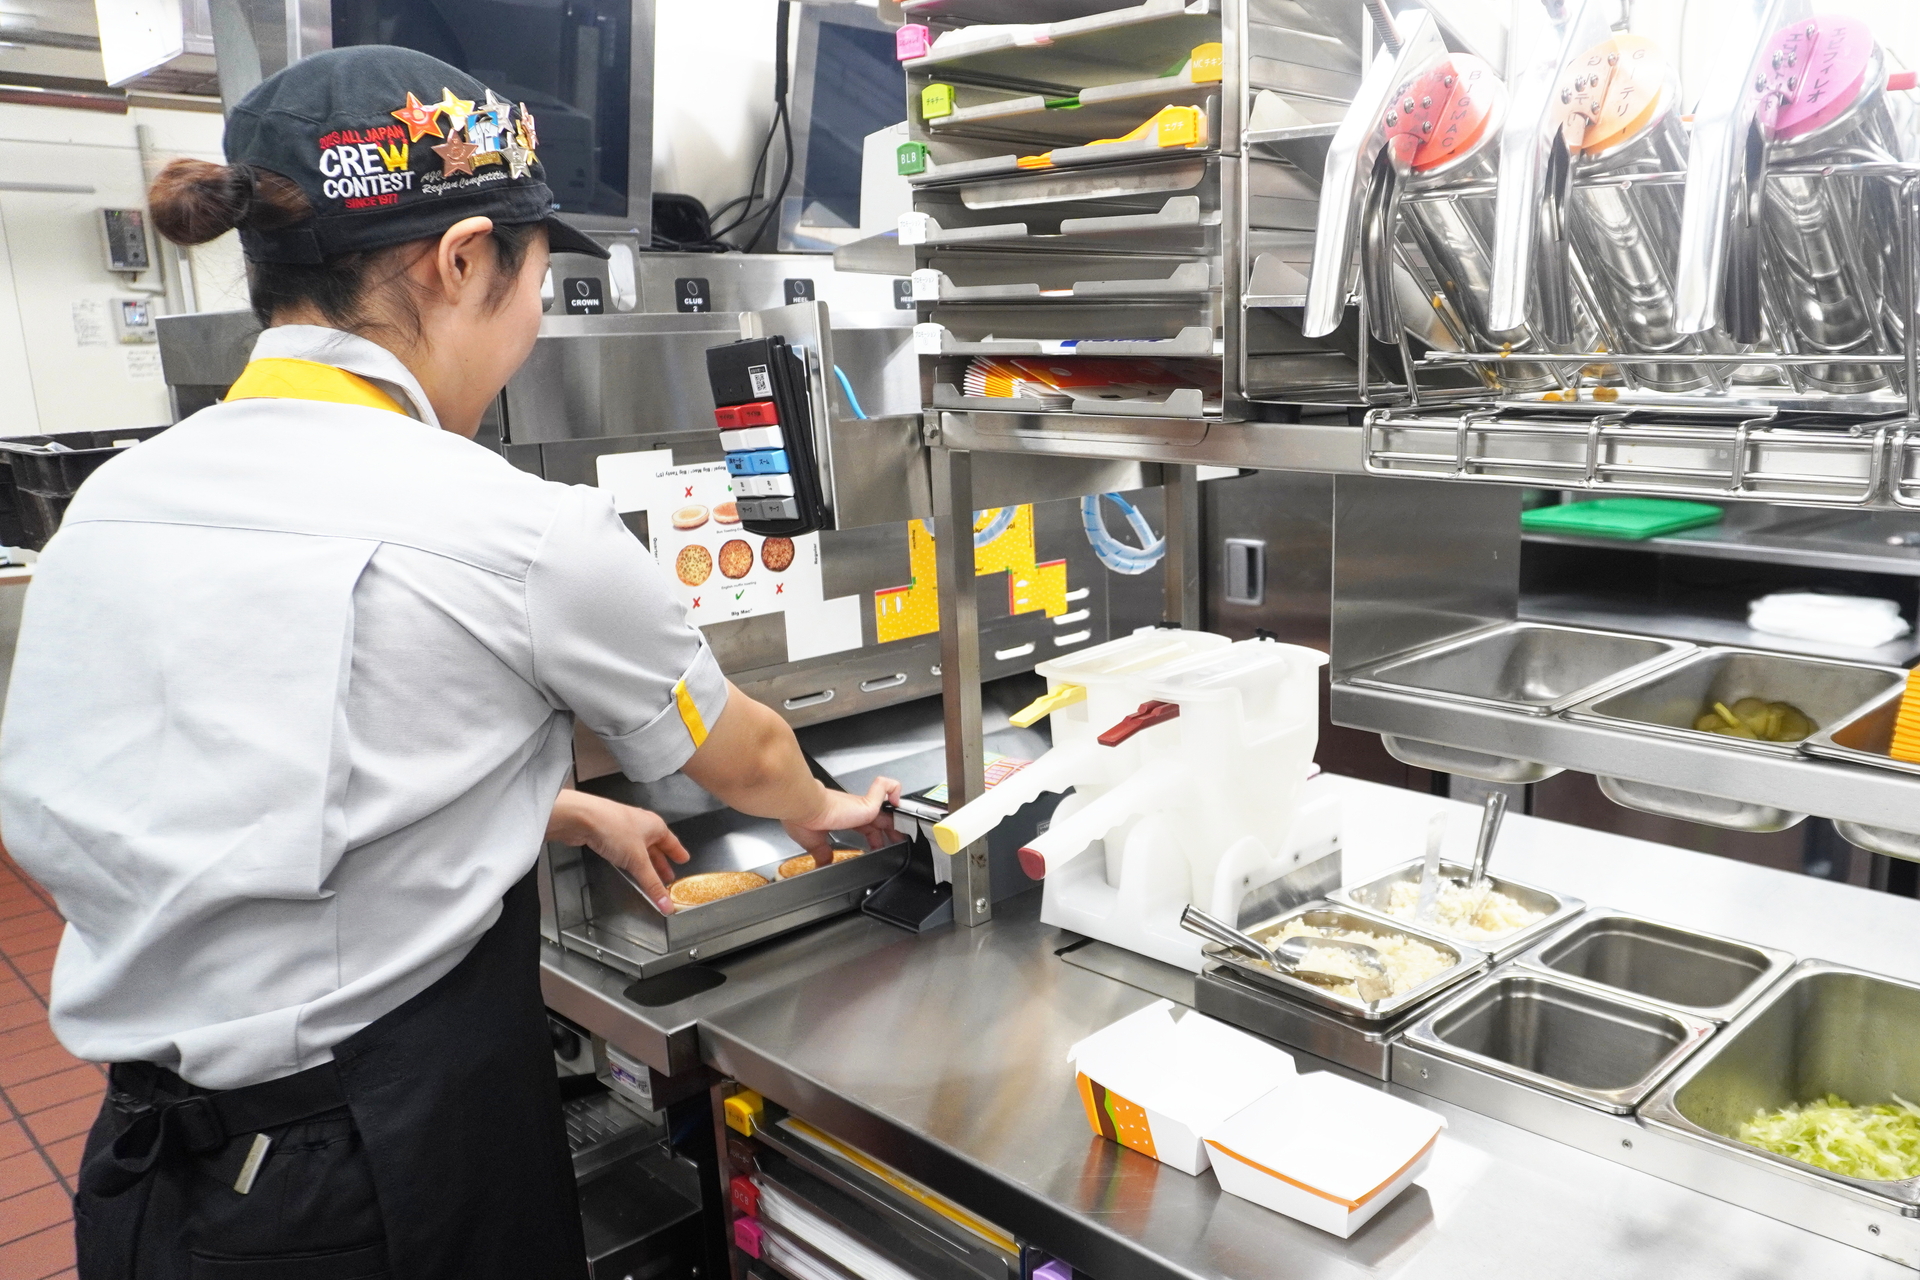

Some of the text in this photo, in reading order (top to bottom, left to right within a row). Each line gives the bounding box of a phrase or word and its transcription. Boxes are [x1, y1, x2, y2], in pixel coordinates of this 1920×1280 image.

[341, 129, 365, 145] ALL
[364, 124, 405, 143] JAPAN
[1164, 121, 1184, 131] エグチ
[319, 138, 409, 178] CREW
[901, 152, 916, 165] BLB
[323, 170, 416, 199] CONTEST
[344, 196, 377, 209] SINCE
[734, 1189, 749, 1206] DCB
